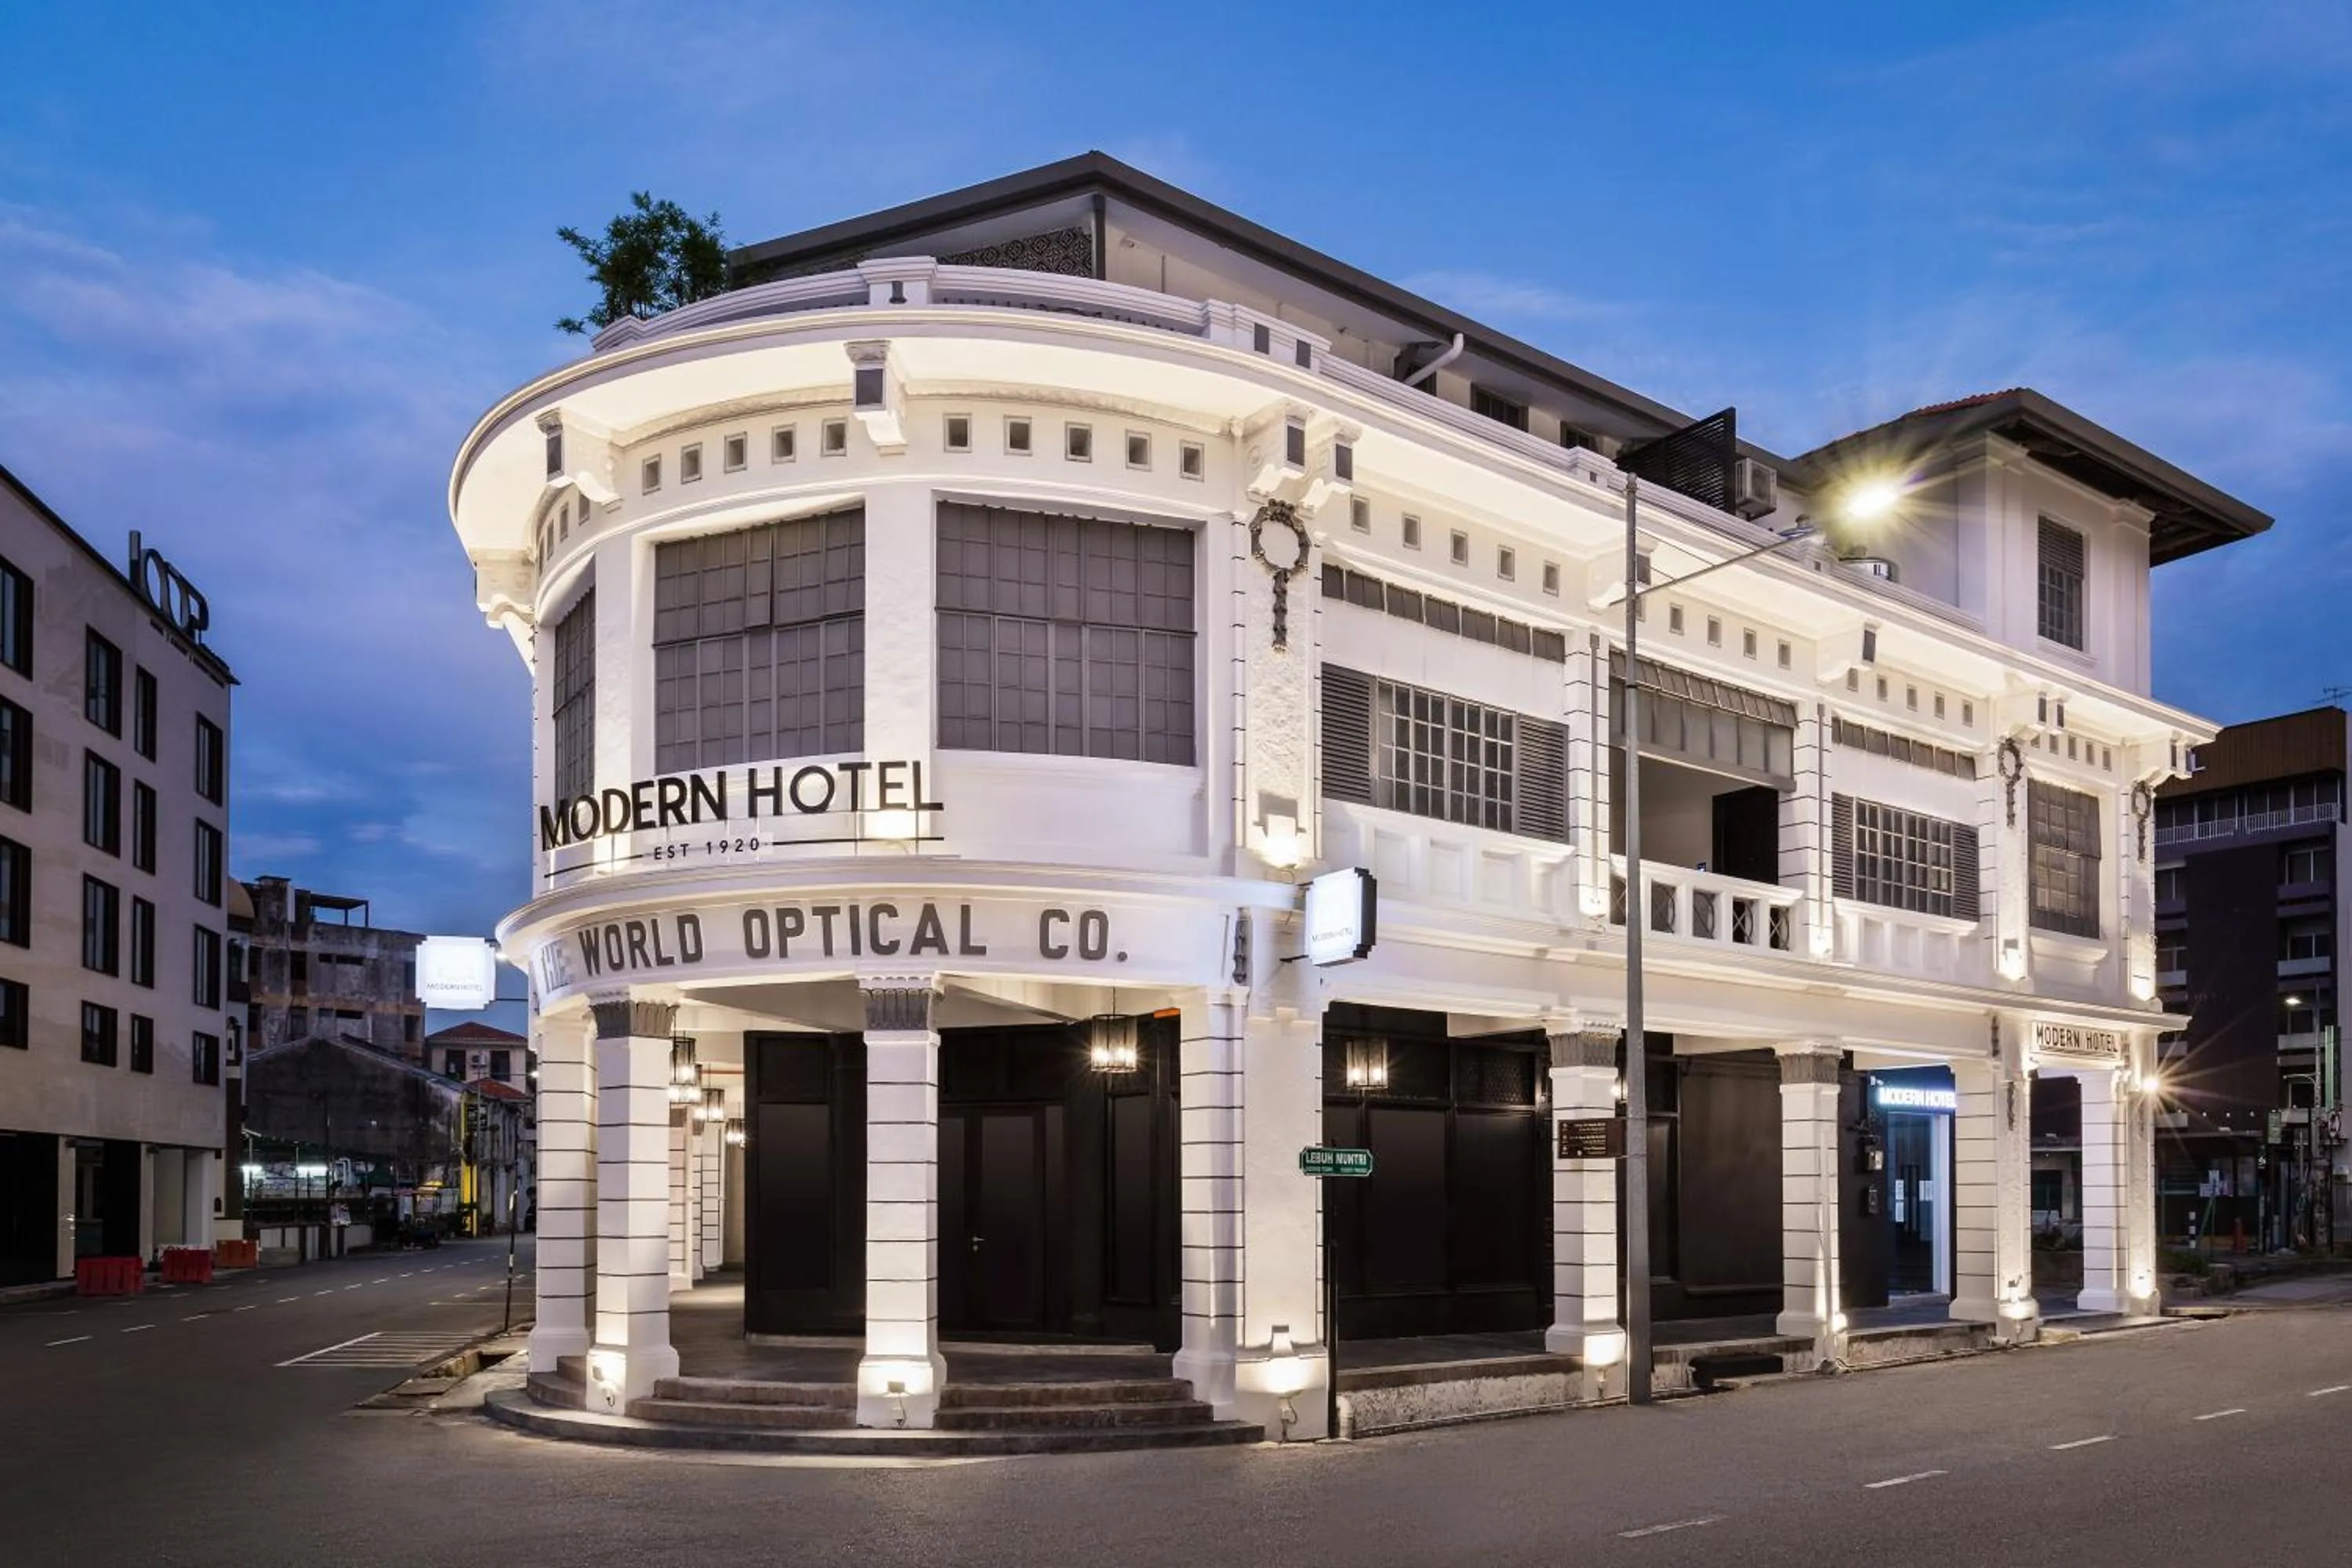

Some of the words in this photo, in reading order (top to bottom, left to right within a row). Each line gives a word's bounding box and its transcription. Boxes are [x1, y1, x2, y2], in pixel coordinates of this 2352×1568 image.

[540, 771, 728, 851] MODERN
[748, 760, 944, 818] HOTEL
[654, 843, 689, 860] EST
[706, 838, 760, 855] 1920
[578, 914, 703, 977] WORLD
[742, 902, 987, 959] OPTICAL
[1039, 909, 1128, 963] CO.
[2036, 1022, 2080, 1048] MODERN
[2086, 1031, 2118, 1052] HOTEL
[1878, 1087, 1923, 1105] MODERN
[1305, 1152, 1334, 1164] LEBUH
[1335, 1153, 1367, 1166] MUNTRI
